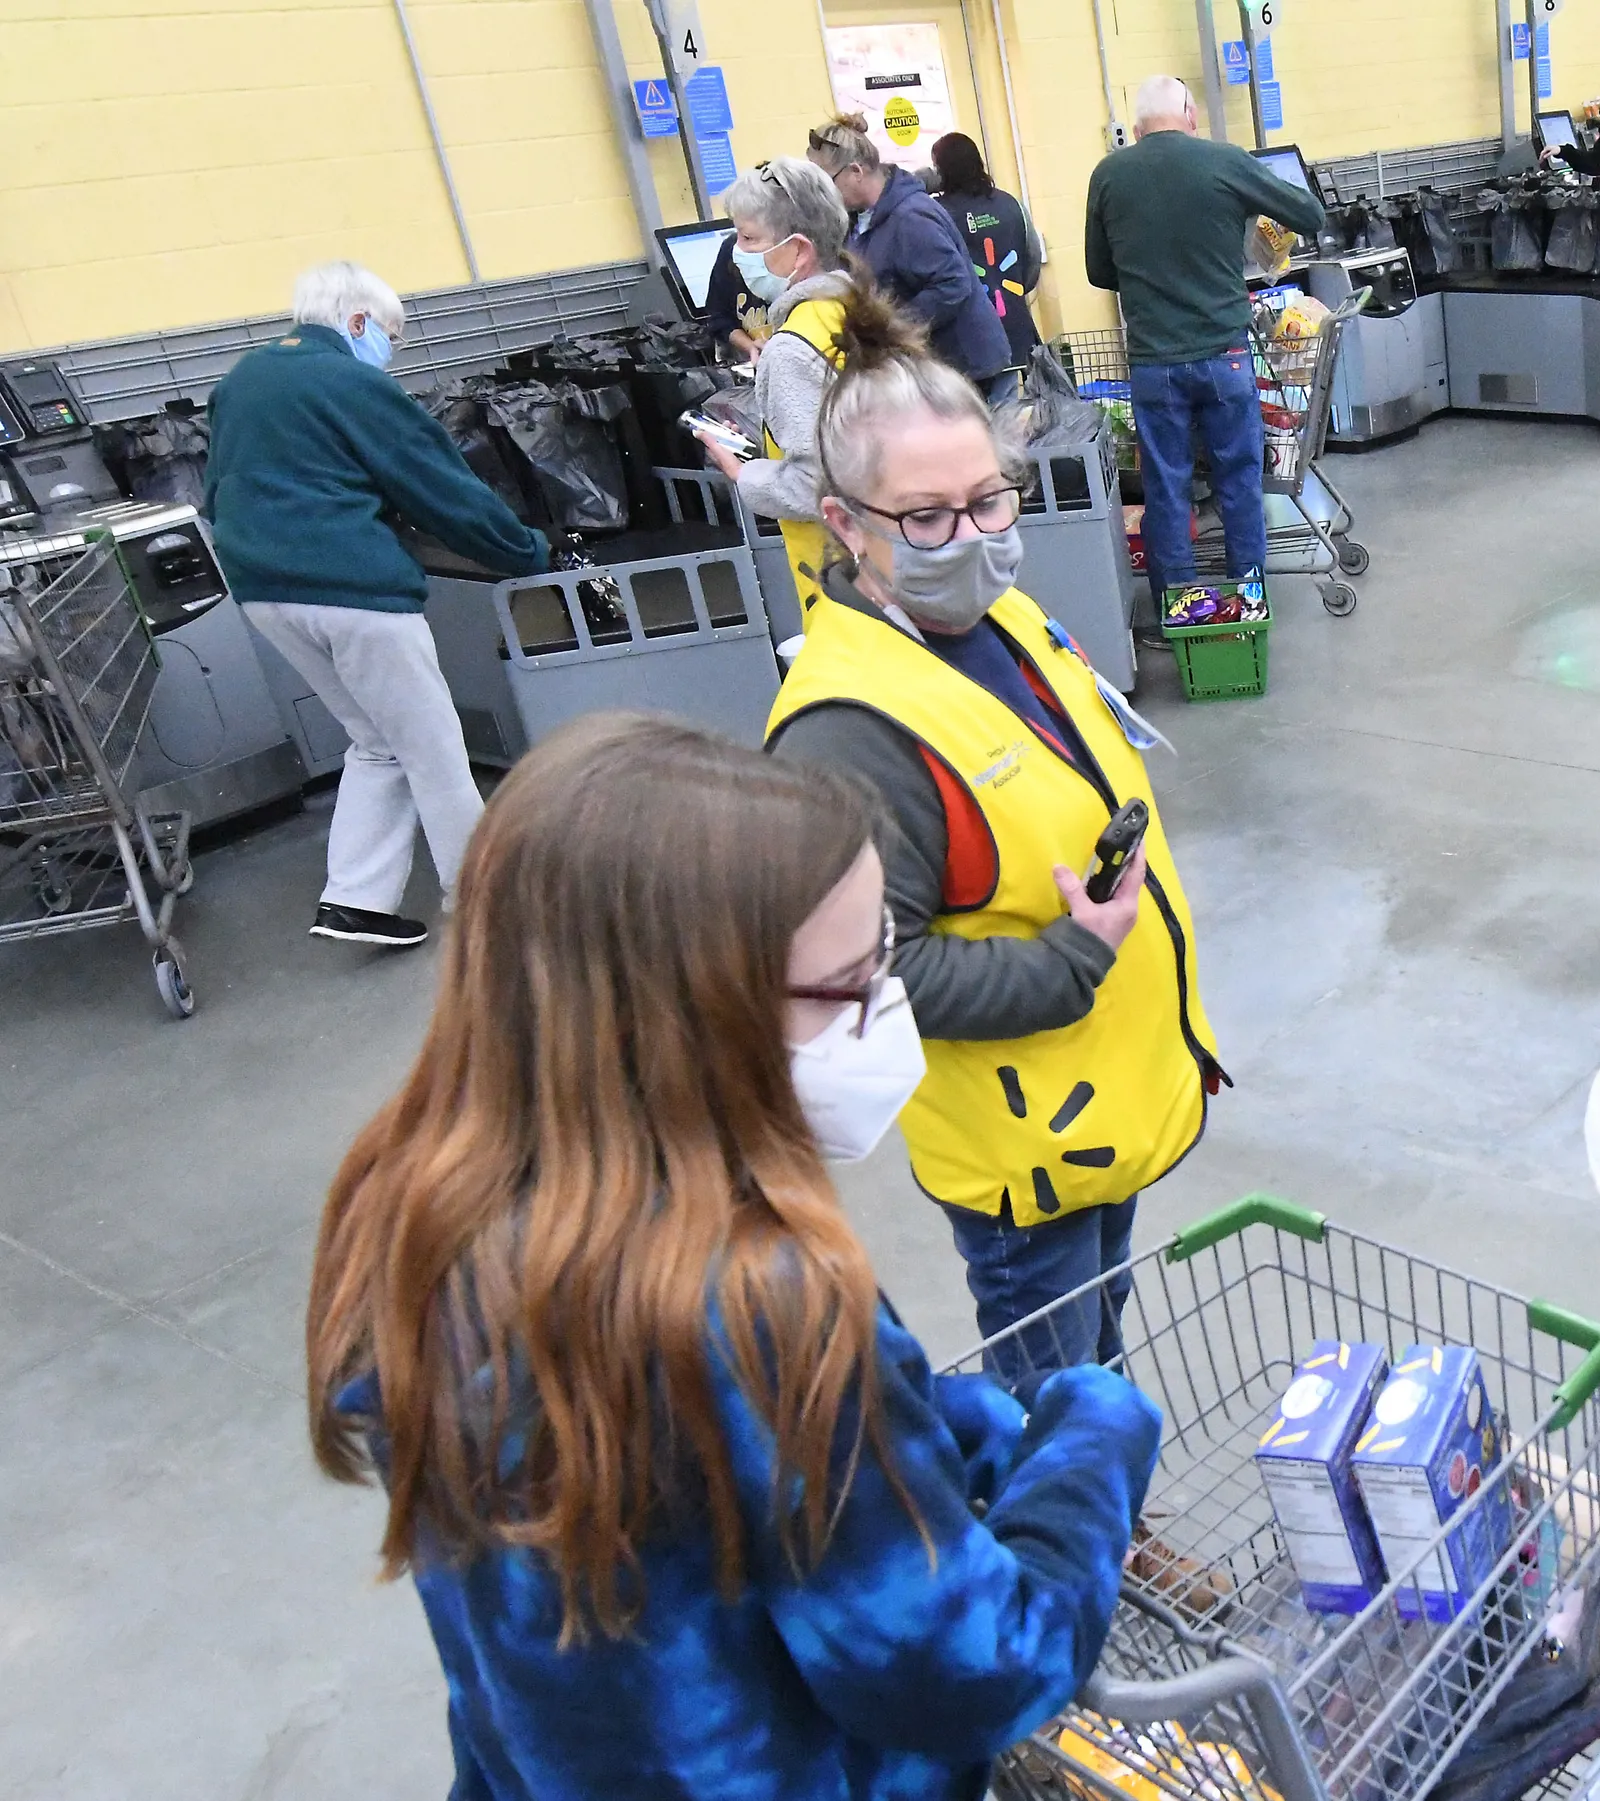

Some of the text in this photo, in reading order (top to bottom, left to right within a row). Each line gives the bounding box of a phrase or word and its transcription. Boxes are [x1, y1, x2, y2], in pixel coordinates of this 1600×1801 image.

[1261, 2, 1273, 25] 6
[684, 28, 698, 59] 4
[871, 75, 901, 84] ASSOCIATES
[886, 107, 914, 115] AUTOMATIC
[885, 115, 919, 128] CAUTION
[1262, 222, 1282, 251] GIANT
